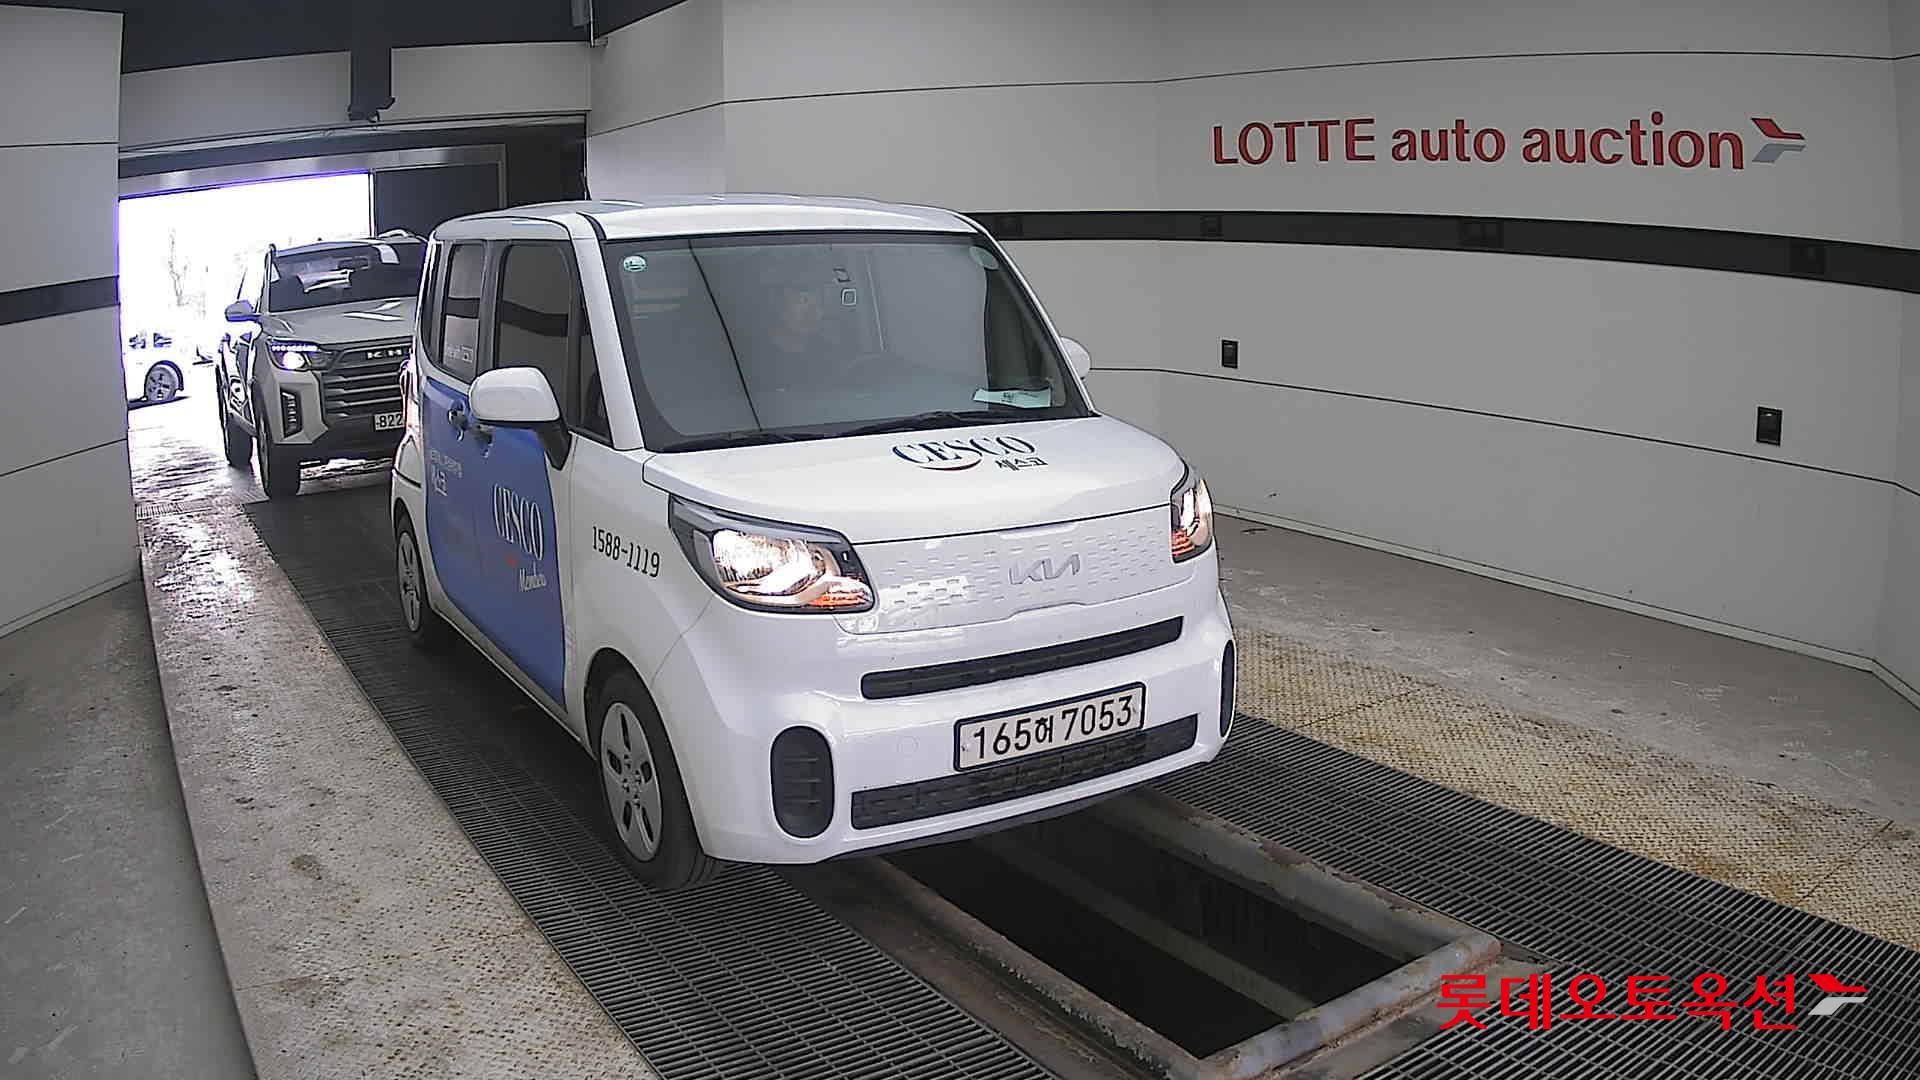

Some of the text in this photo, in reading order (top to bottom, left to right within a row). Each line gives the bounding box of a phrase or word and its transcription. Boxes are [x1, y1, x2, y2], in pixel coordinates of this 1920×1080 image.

[1212, 111, 1744, 169] LOTTE auto auction
[892, 435, 1036, 464] CESCO
[994, 456, 1048, 471] 세스코
[493, 482, 545, 561] CESCO
[592, 525, 660, 578] 1588-1119
[1008, 553, 1081, 585] KIA
[1061, 694, 1133, 742] 7053
